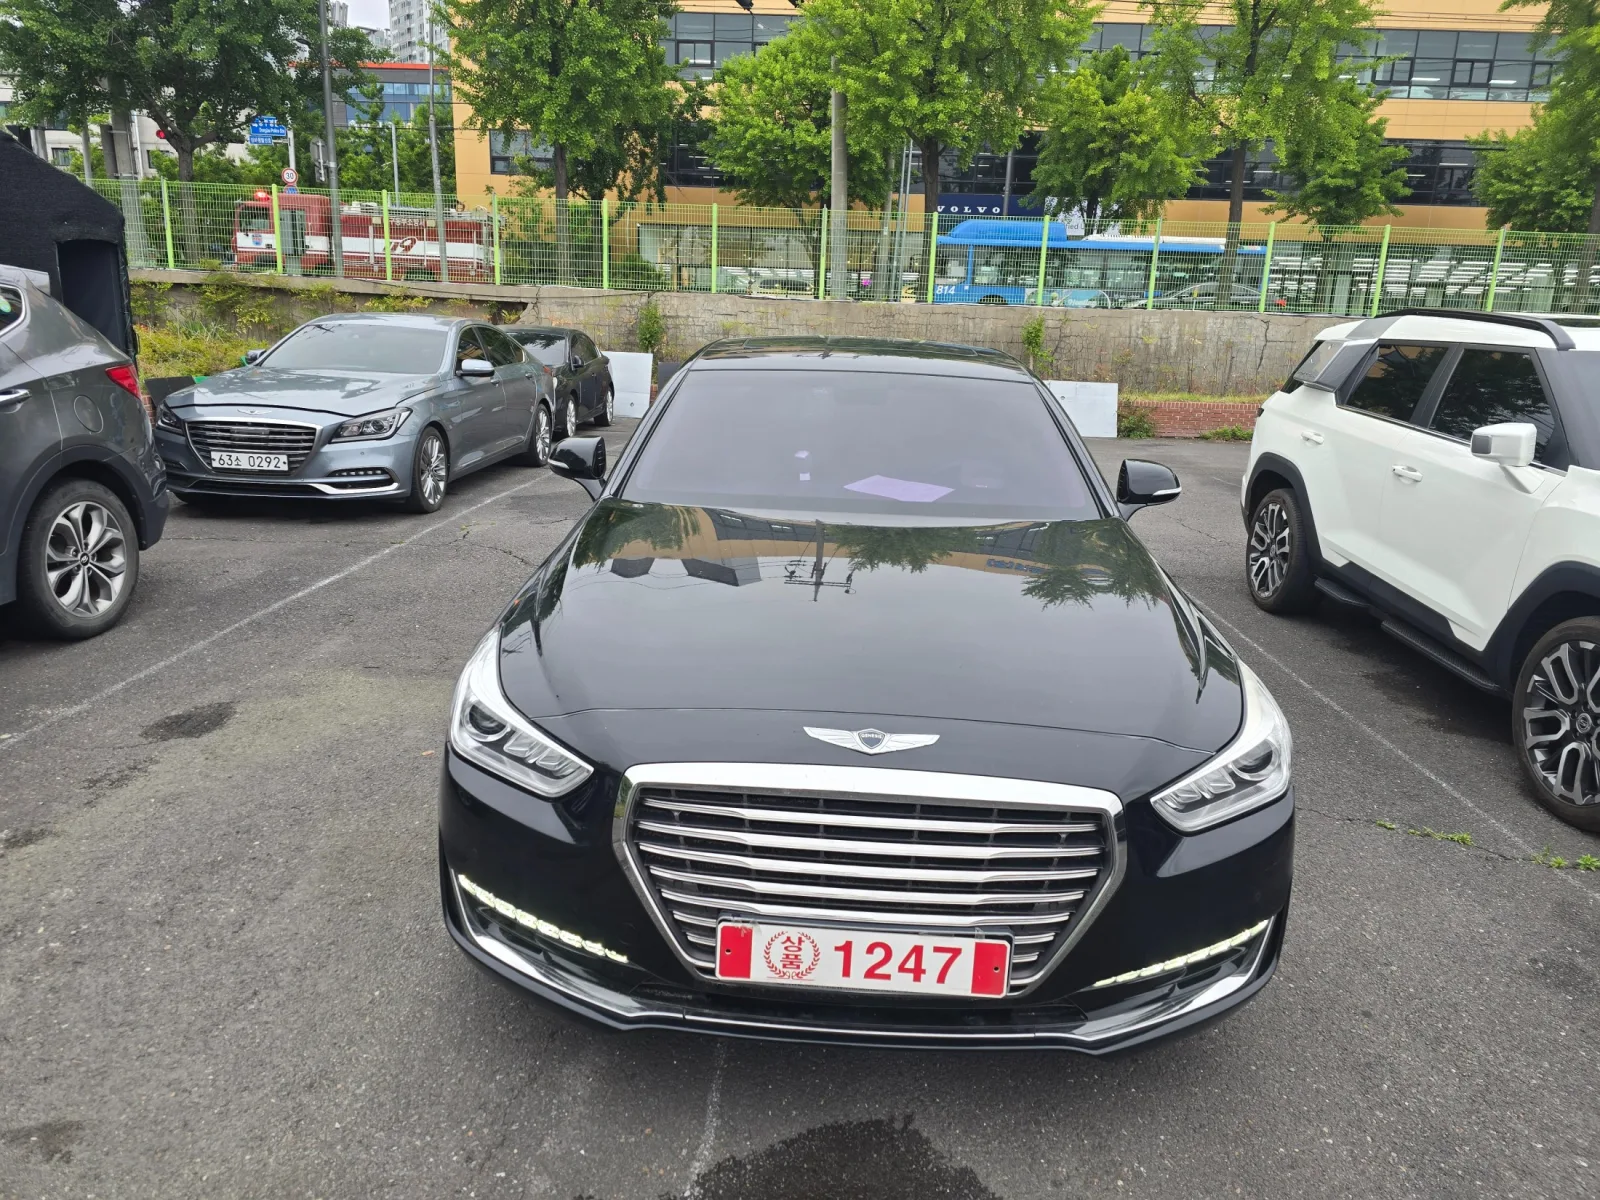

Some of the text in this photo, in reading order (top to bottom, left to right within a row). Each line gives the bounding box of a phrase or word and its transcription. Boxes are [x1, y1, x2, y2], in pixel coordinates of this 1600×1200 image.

[285, 172, 294, 180] 30
[936, 205, 1001, 214] VOLVO
[936, 285, 956, 295] 814
[218, 454, 281, 469] 63소 0292
[780, 935, 804, 970] 상품
[833, 939, 963, 985] 1247
